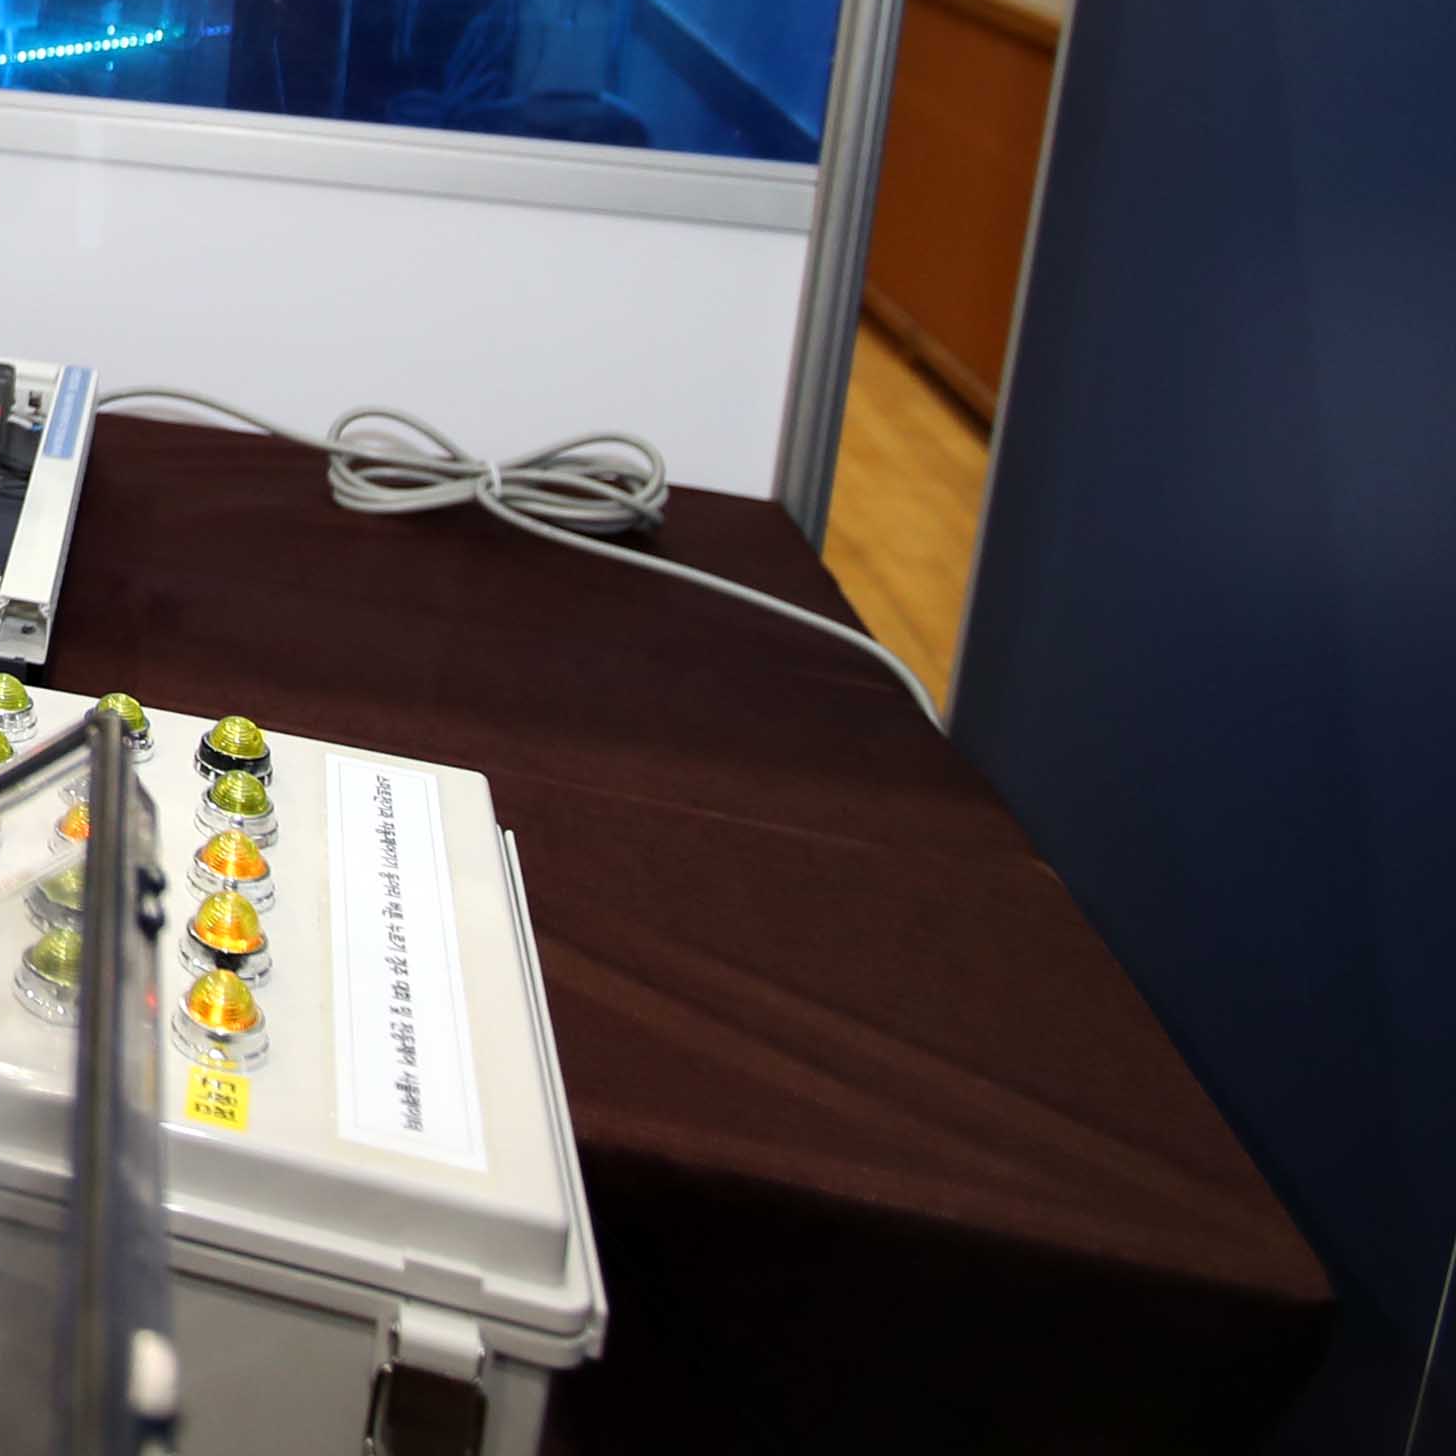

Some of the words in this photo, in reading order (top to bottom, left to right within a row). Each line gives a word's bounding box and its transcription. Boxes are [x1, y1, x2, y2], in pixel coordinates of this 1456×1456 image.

[379, 872, 401, 897] 동아리
[381, 901, 404, 919] 버튼
[388, 924, 406, 953] 누르기
[391, 980, 411, 1002] 대회
[390, 1006, 412, 1018] 및
[395, 1071, 423, 1132] 시뮬레이터
